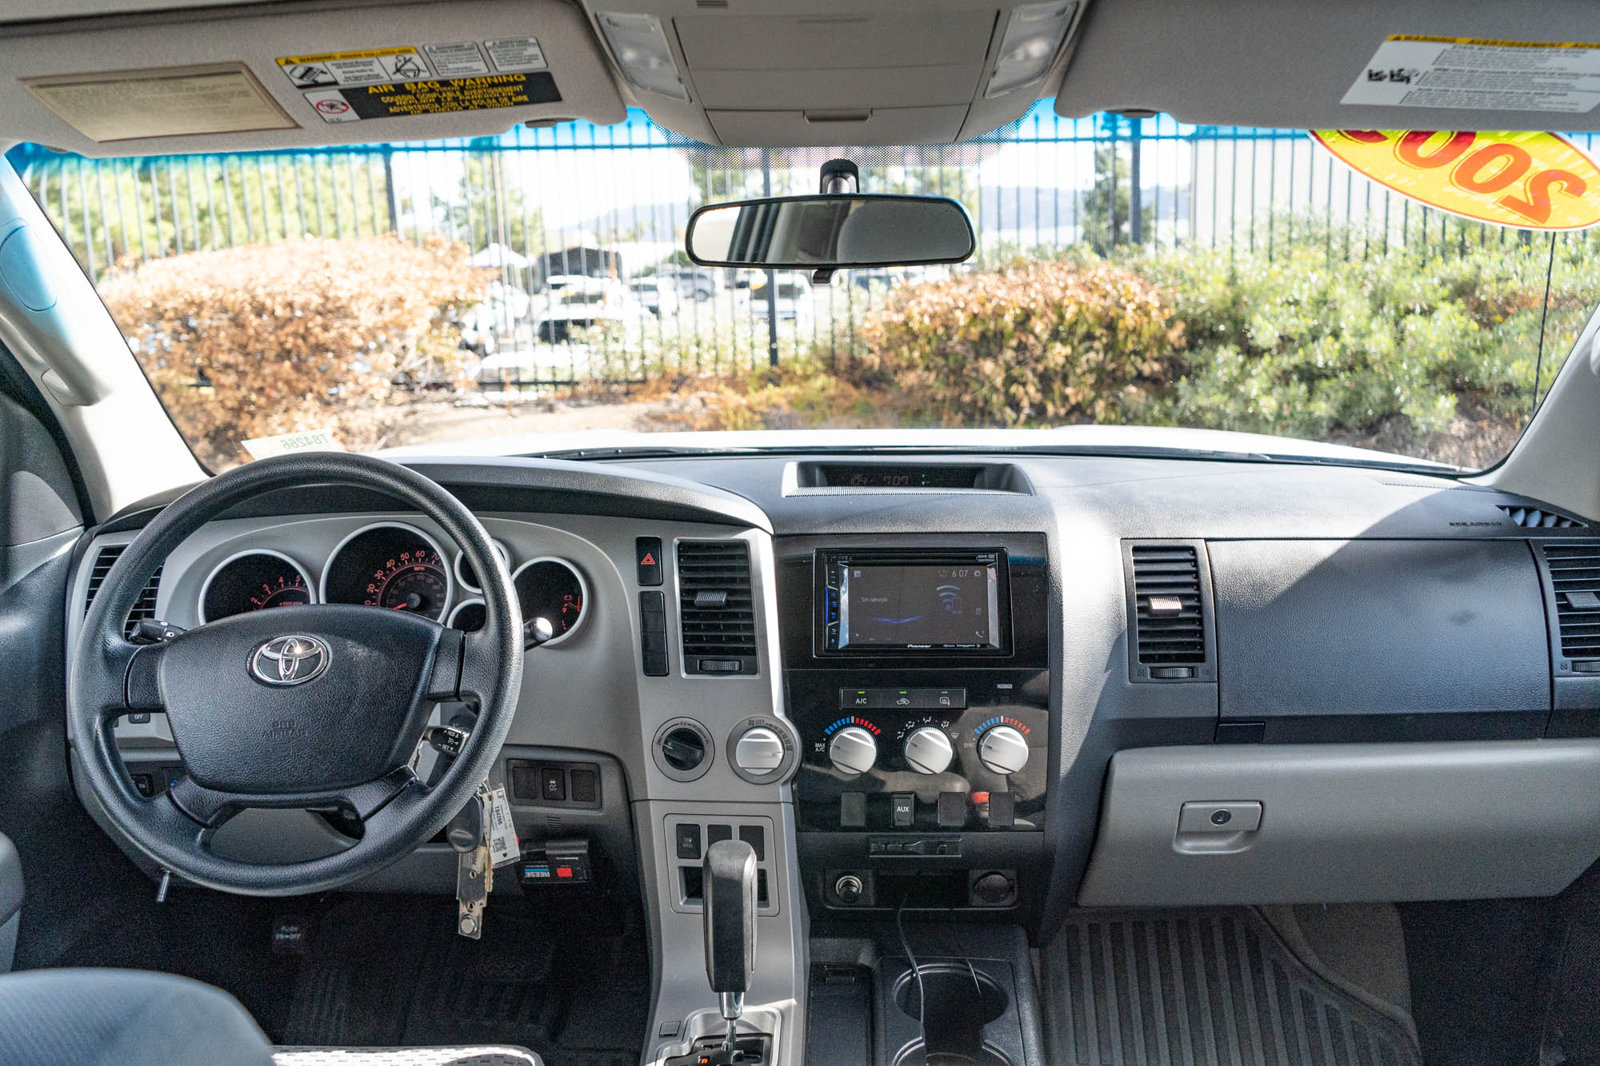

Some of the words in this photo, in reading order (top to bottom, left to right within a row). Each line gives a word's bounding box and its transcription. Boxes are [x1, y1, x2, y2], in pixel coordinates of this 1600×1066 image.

[367, 84, 396, 94] AIR
[403, 80, 440, 91] BAG
[449, 73, 527, 88] WARNING
[400, 552, 410, 561] 50
[415, 550, 426, 558] 60
[386, 558, 396, 569] 40
[374, 569, 384, 580] 30
[366, 583, 376, 594] 20
[855, 697, 868, 705] A/C
[896, 805, 910, 813] AUX
